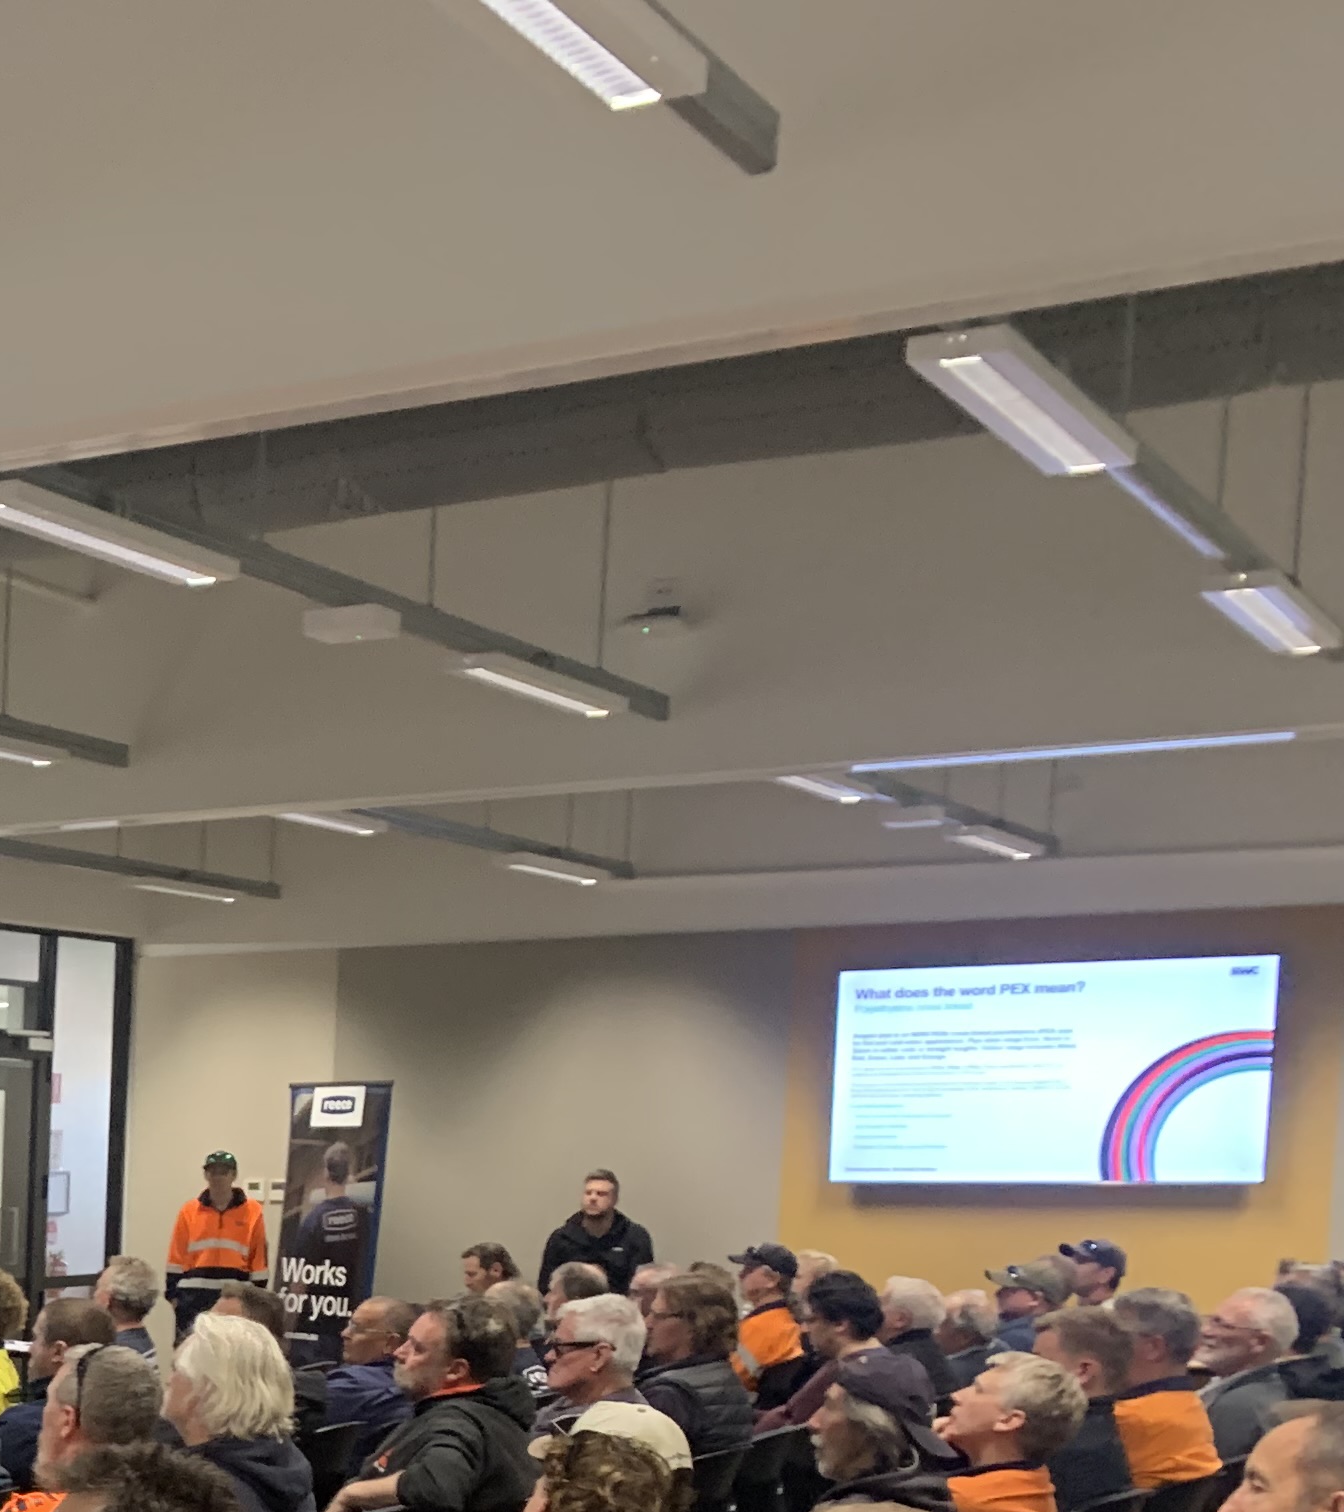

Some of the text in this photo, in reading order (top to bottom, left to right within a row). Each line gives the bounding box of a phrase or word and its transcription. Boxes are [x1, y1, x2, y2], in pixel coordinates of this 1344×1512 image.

[855, 980, 1086, 1000] What does the word PEX mean?
[281, 1256, 347, 1287] Works
[309, 1295, 352, 1321] you.
